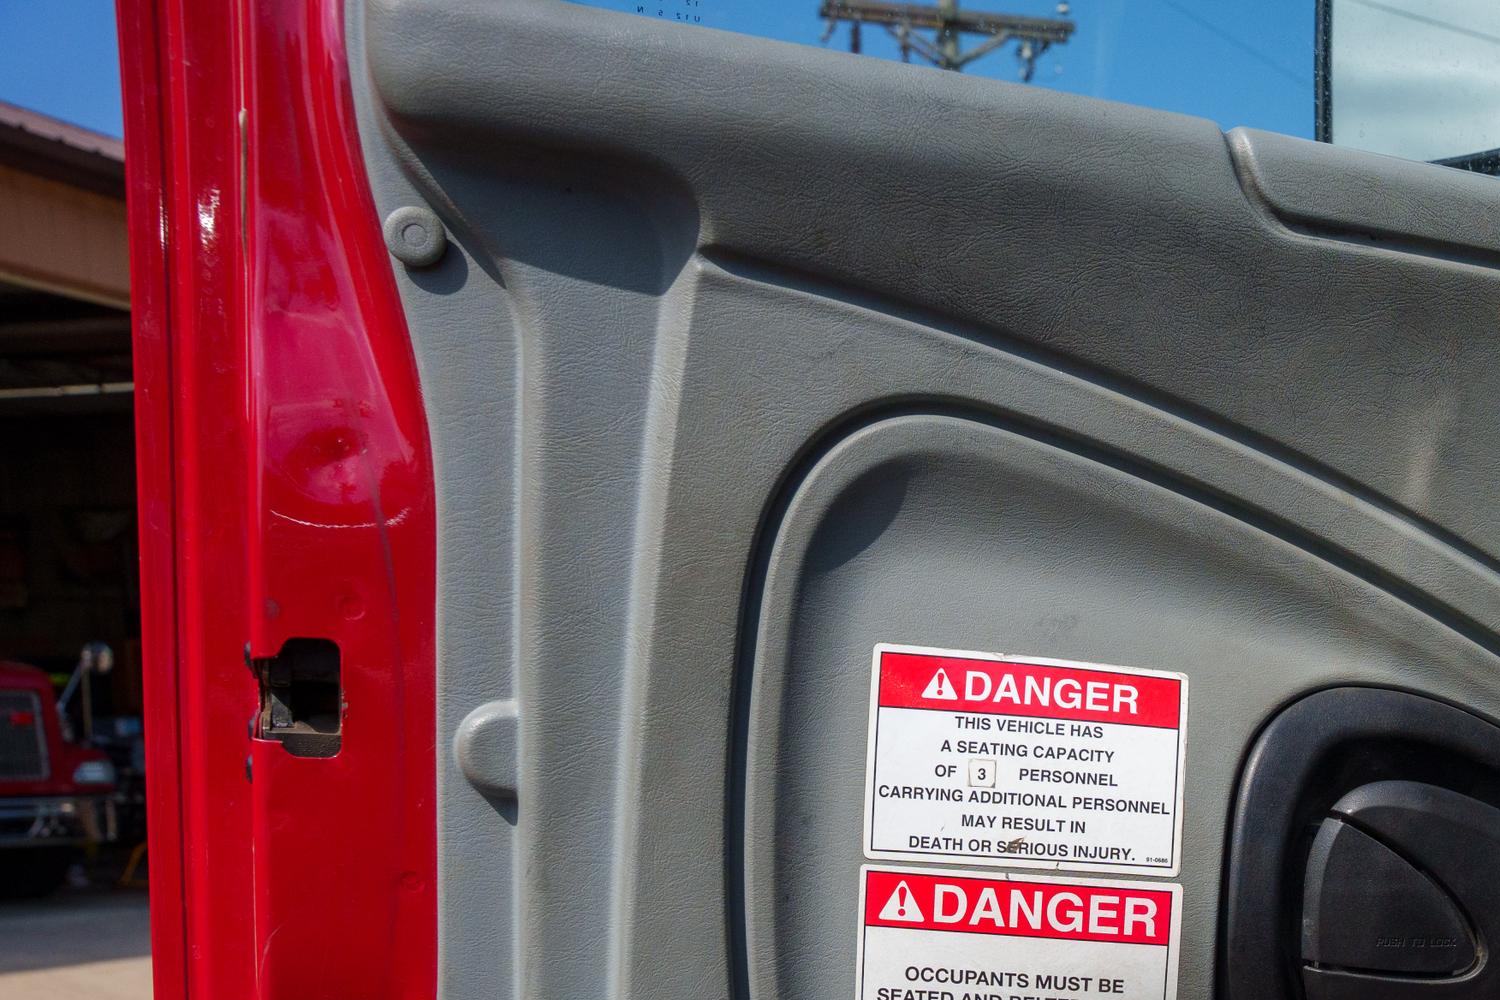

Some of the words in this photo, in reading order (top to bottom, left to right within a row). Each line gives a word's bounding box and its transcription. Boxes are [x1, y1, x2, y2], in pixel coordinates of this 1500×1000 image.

[964, 670, 1139, 714] DANGER
[955, 716, 991, 731] THIS
[996, 719, 1065, 736] VEHICLE
[1070, 725, 1103, 739] HAS
[940, 740, 952, 753] A
[957, 741, 1028, 758] SEATING
[1033, 746, 1114, 763] CAPACITY
[935, 764, 957, 778] OF
[977, 768, 986, 780] 3
[1019, 768, 1118, 787] PERSONNEL
[878, 785, 963, 803] CARRYING
[968, 790, 1067, 808] ADDITIONAL
[1072, 797, 1170, 815] PERSONNEL
[961, 814, 997, 829] MAY
[1001, 817, 1066, 833] RESULT
[1070, 821, 1086, 834] IN
[909, 836, 963, 852] DEATH
[968, 839, 992, 853] OR
[996, 840, 1069, 857] SERIOUS
[1073, 846, 1136, 861] INJURY.
[933, 884, 1158, 937] DANGER
[905, 966, 1030, 988] OCCUPANTS
[1035, 975, 1092, 992] MUST
[1098, 979, 1124, 993] BE
